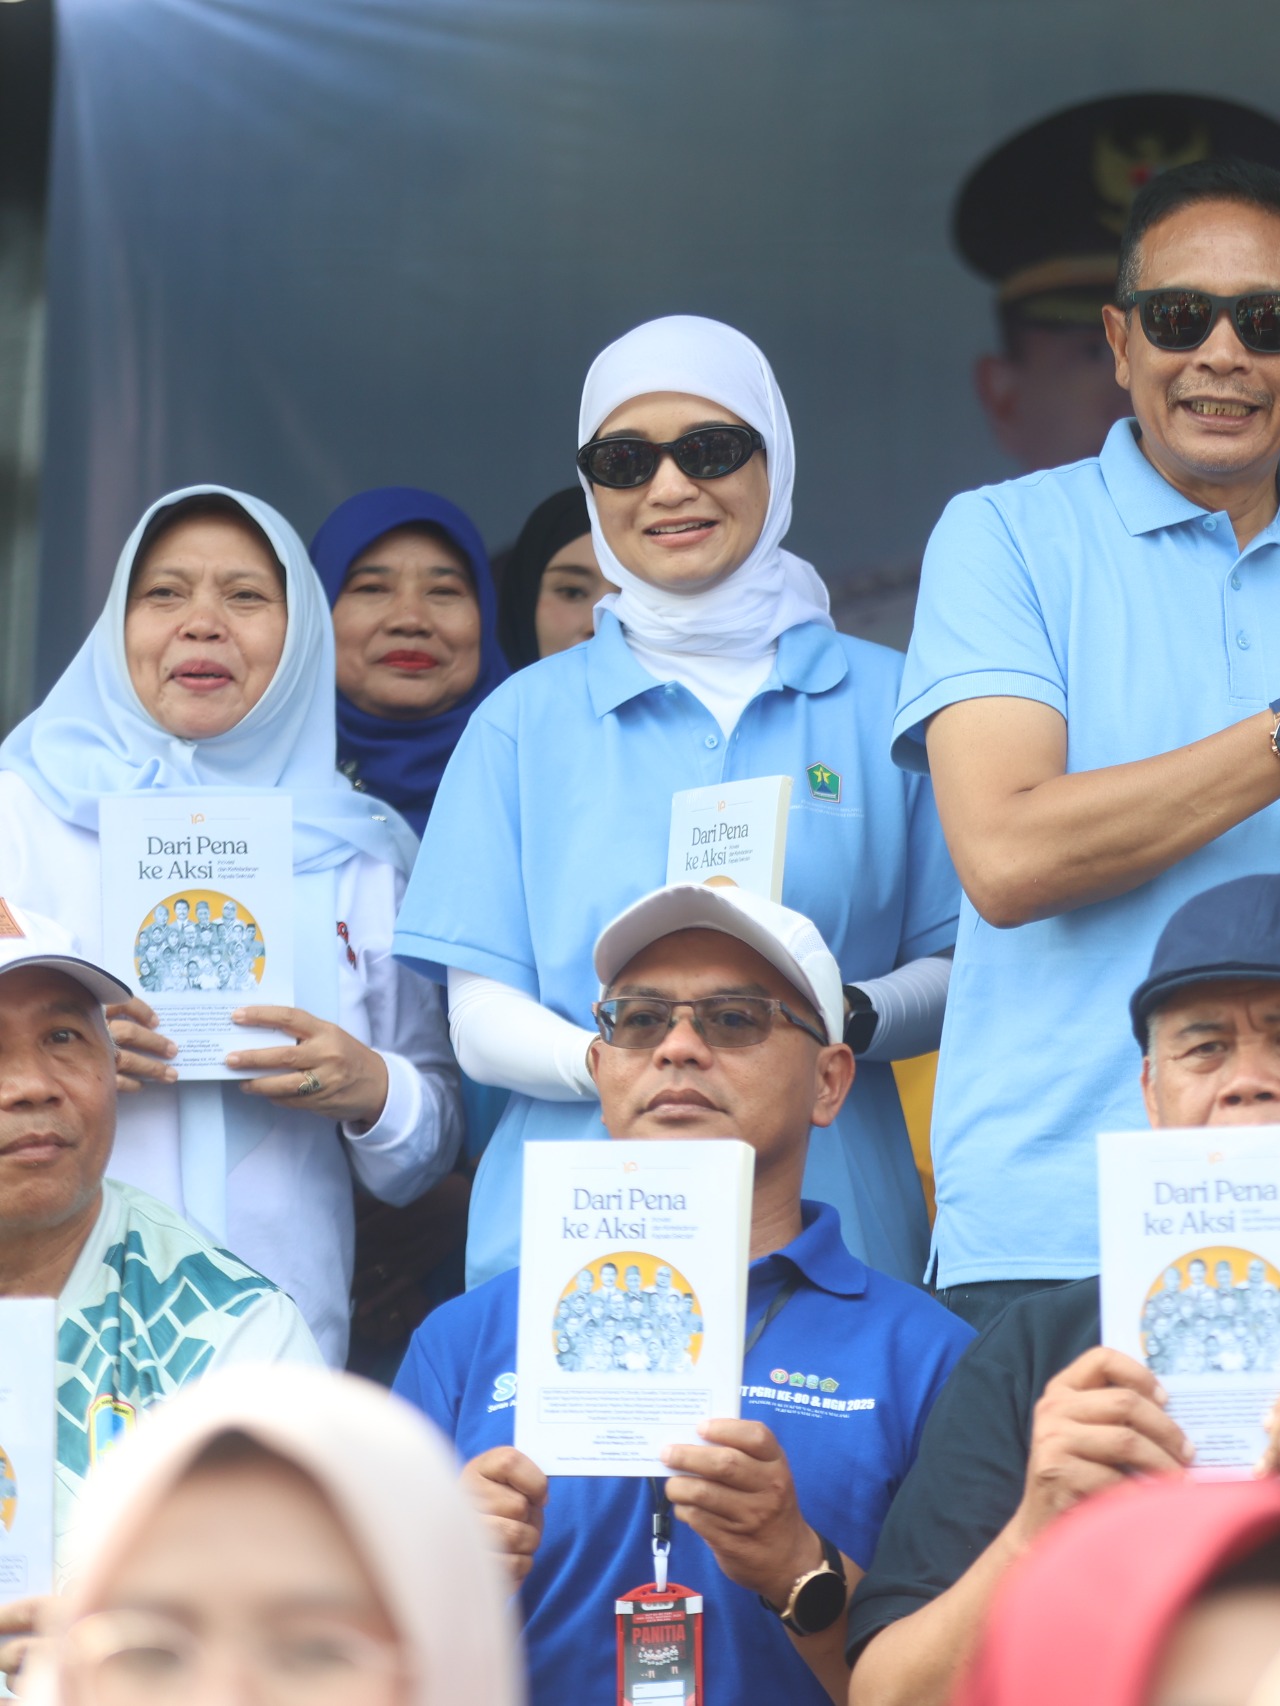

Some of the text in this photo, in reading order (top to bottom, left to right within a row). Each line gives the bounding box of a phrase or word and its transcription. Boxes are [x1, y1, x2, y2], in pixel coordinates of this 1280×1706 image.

[691, 822, 749, 846] Dari Pena
[147, 836, 248, 856] Dari Pena
[138, 860, 213, 880] ke Aksi
[685, 852, 699, 871] ke
[700, 846, 727, 868] Aksi
[574, 1188, 687, 1210] Dari Pena
[1154, 1179, 1277, 1205] Dari Pena
[562, 1216, 589, 1239] ke
[595, 1216, 646, 1239] Aksi
[1144, 1212, 1173, 1236] ke
[1180, 1210, 1235, 1235] Aksi
[749, 1386, 776, 1399] PGRI
[776, 1390, 810, 1404] KE-80
[810, 1396, 821, 1407] &
[846, 1398, 876, 1411] 2025
[632, 1624, 686, 1645] PANITIA
